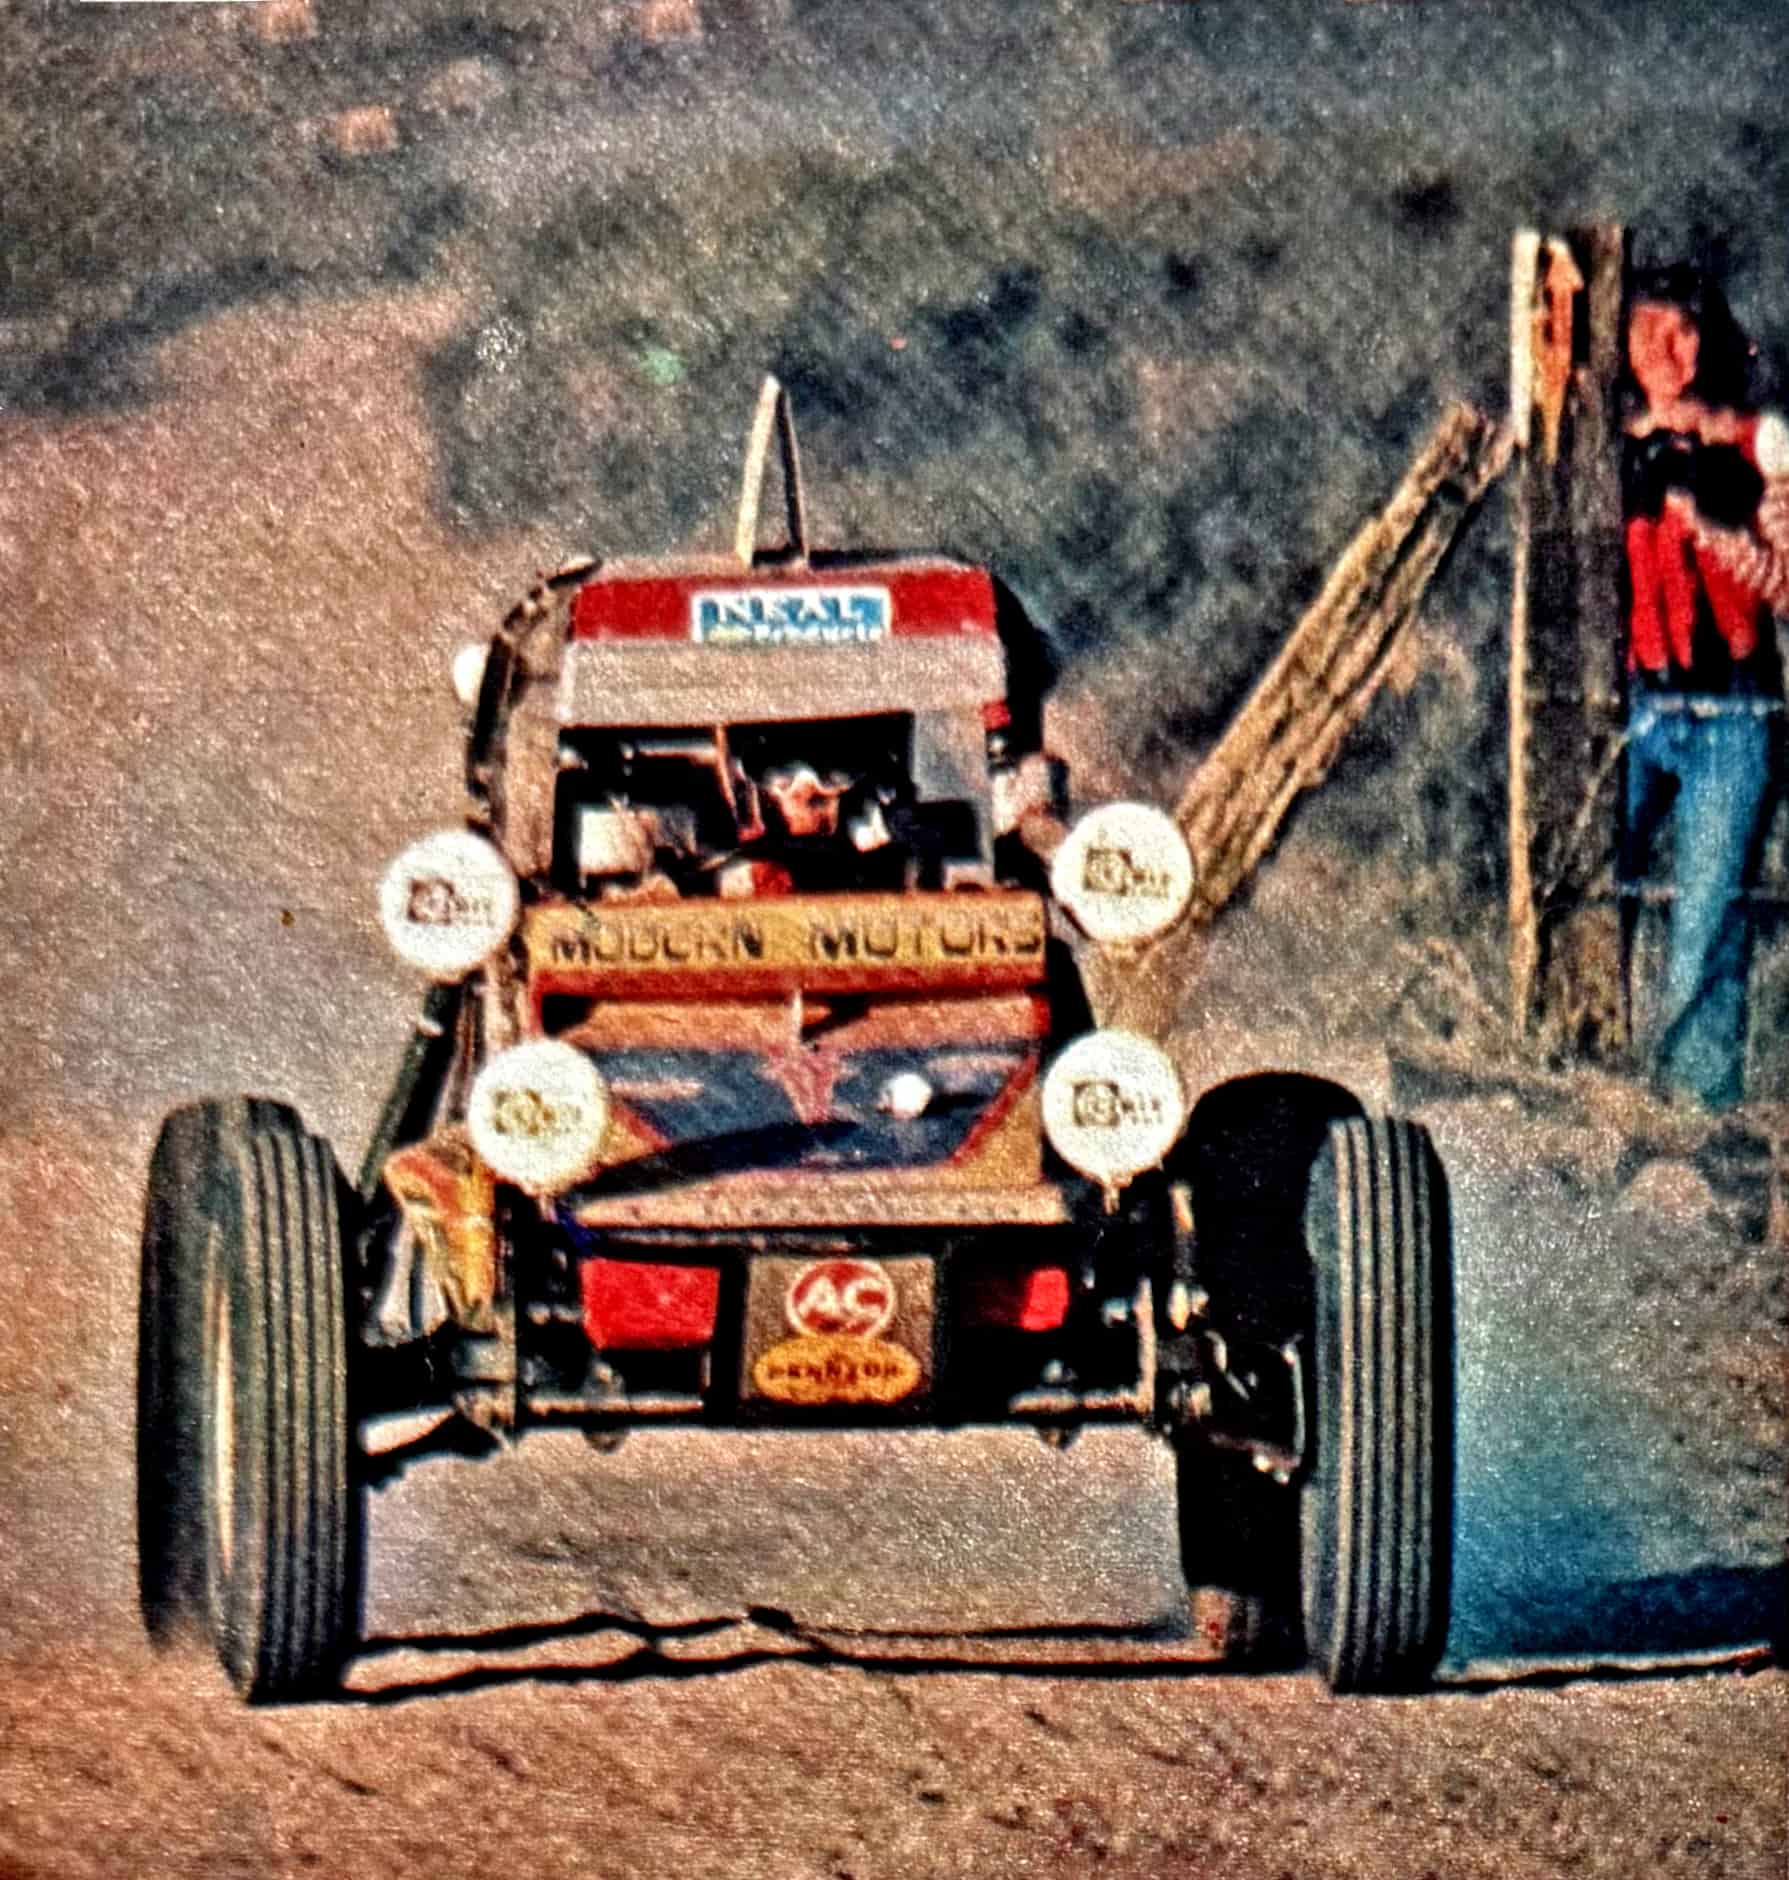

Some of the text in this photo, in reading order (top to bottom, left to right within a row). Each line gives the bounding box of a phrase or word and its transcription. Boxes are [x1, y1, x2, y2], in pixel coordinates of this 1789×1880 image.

[551, 911, 1042, 963] MODERN MOTORS
[798, 1275, 887, 1318] AC
